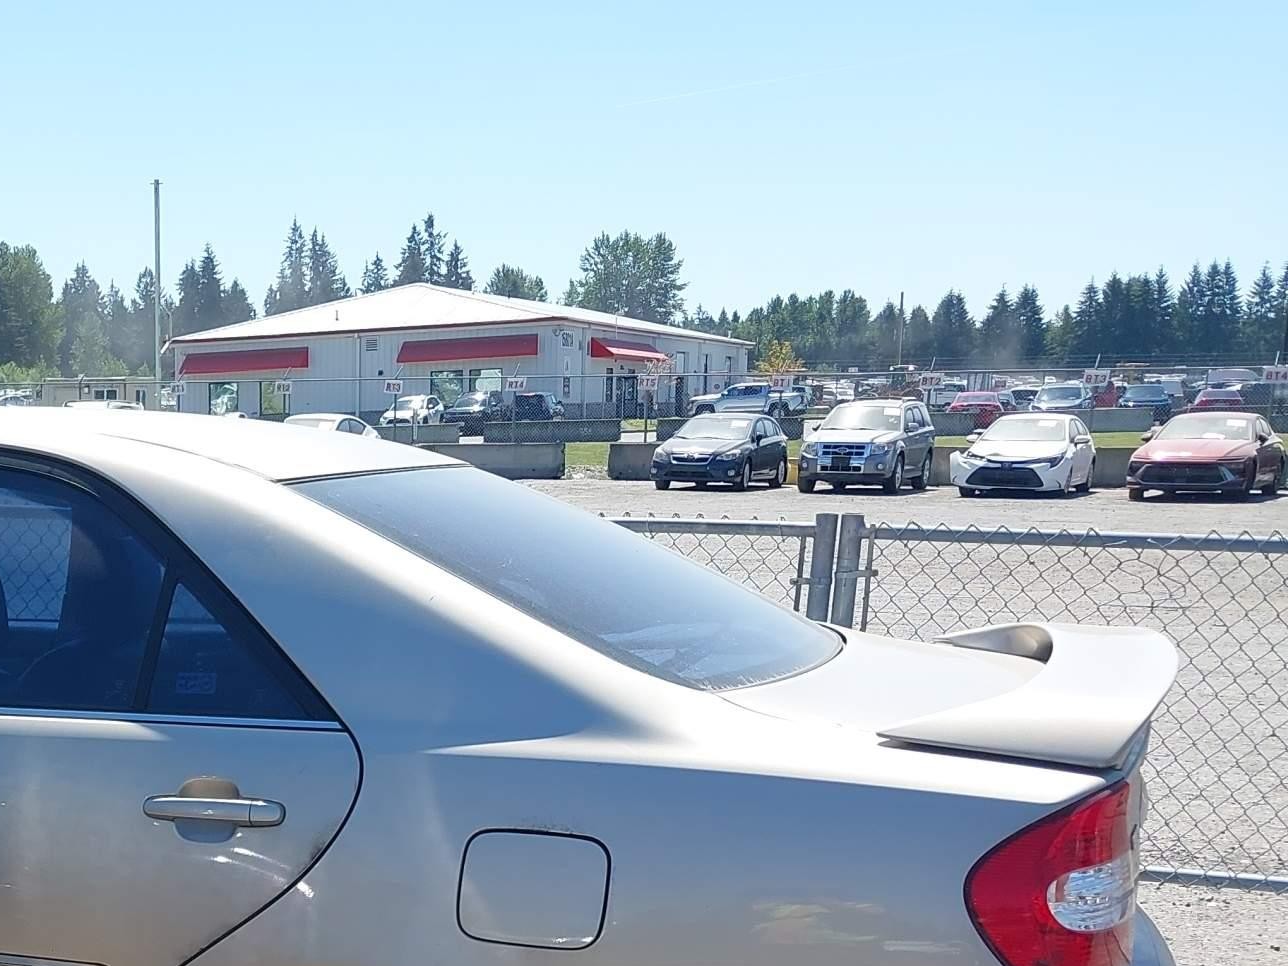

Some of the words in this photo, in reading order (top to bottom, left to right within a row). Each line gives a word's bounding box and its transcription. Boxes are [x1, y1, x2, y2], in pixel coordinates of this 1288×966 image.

[1085, 374, 1106, 384] BT3
[1266, 371, 1288, 380] BT4
[508, 380, 524, 389] RT4
[639, 378, 656, 387] RT5
[921, 377, 941, 386] BT2
